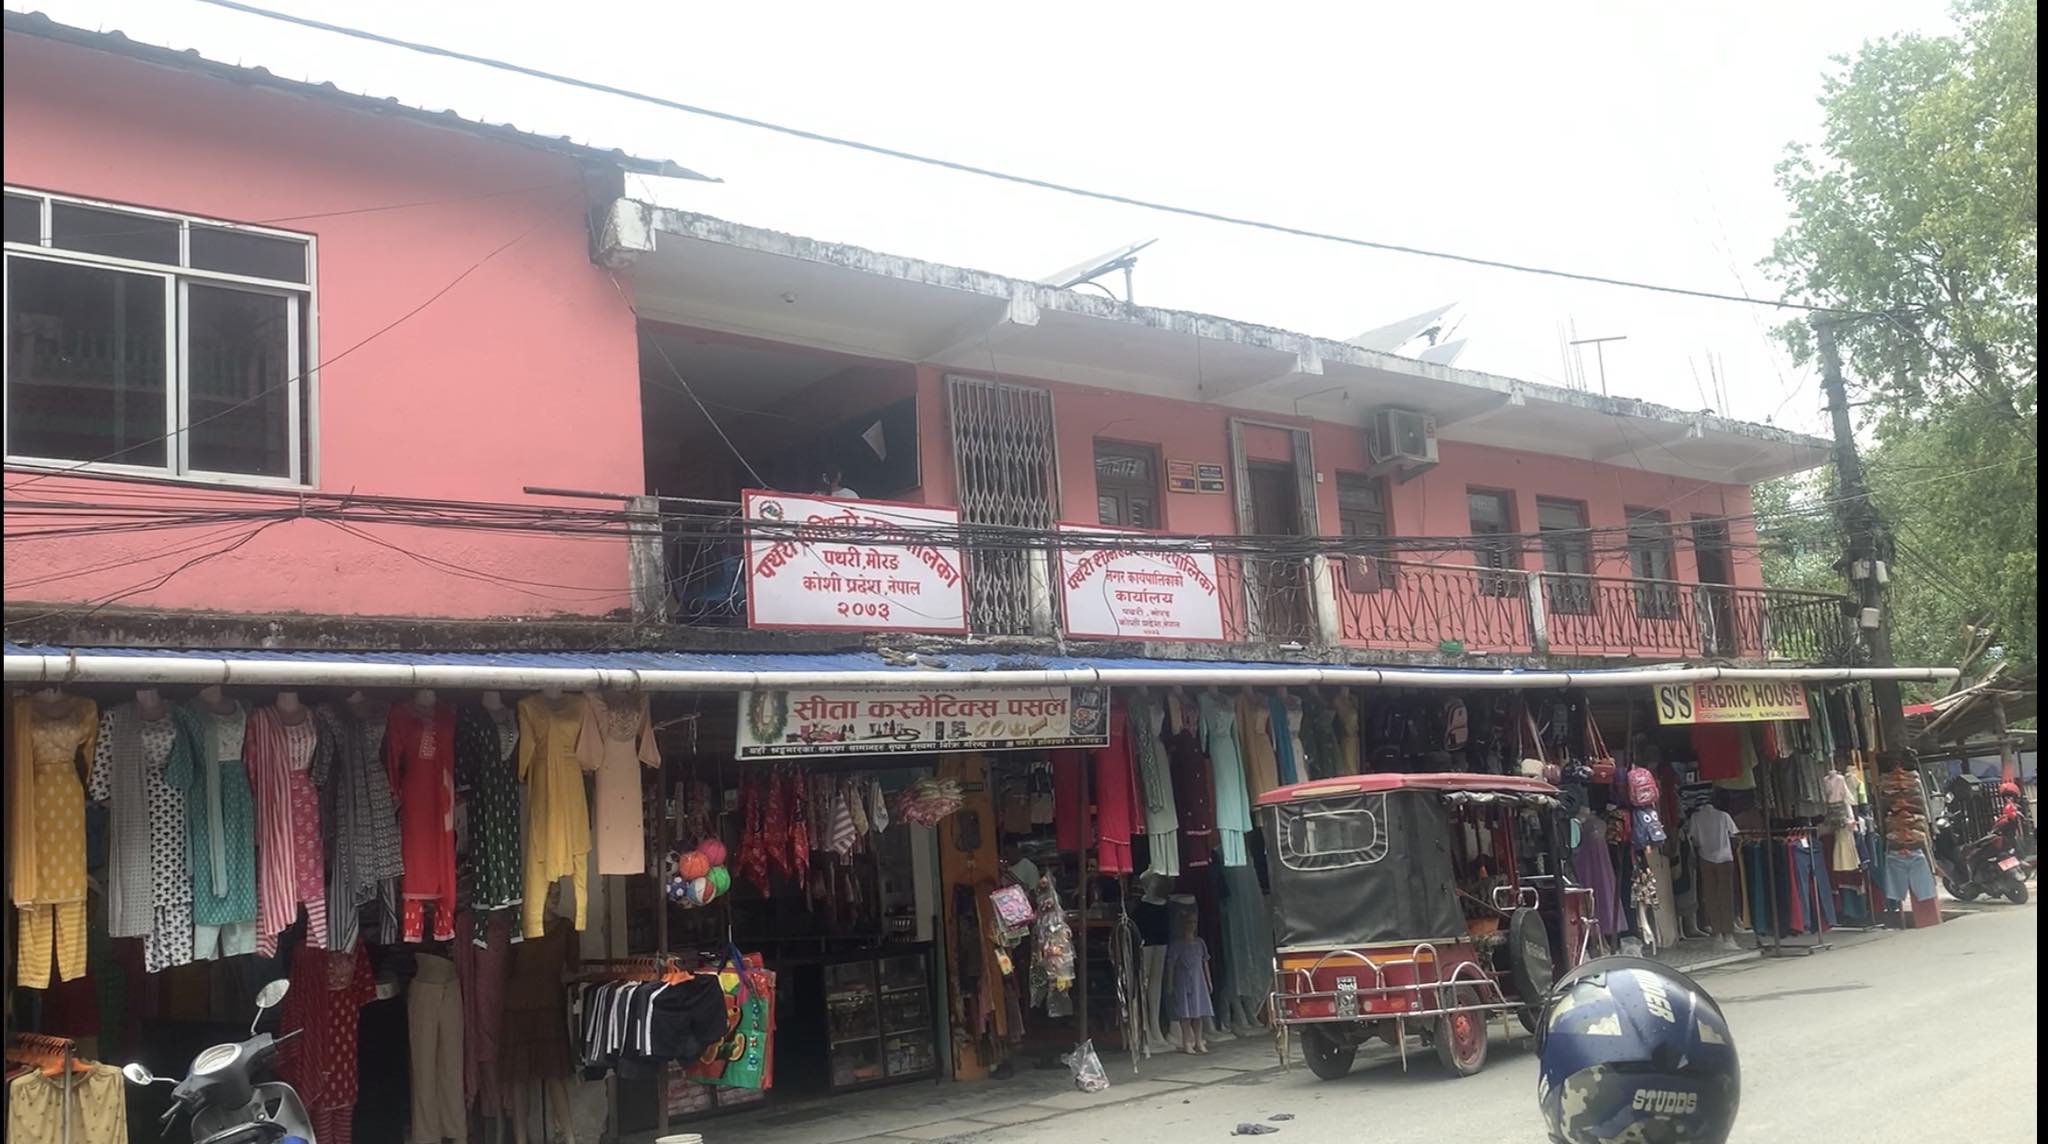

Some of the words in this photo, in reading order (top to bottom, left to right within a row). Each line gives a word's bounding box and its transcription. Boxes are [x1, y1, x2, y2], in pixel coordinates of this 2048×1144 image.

[803, 571, 841, 594] कोशी
[888, 575, 921, 595] नेपाल
[1067, 557, 1095, 590] पथरी
[1106, 569, 1126, 584] नगर
[1114, 588, 1174, 605] कार्यालय
[837, 601, 890, 621] २०७३
[793, 694, 860, 721] सीता
[868, 694, 999, 720] कस्मेटिक्स
[1007, 697, 1068, 717] पसल
[1660, 685, 1692, 720] S'S
[1699, 684, 1750, 709] FABRIC
[1753, 683, 1802, 707] HOUSE
[1632, 1088, 1698, 1114] STUDDS
